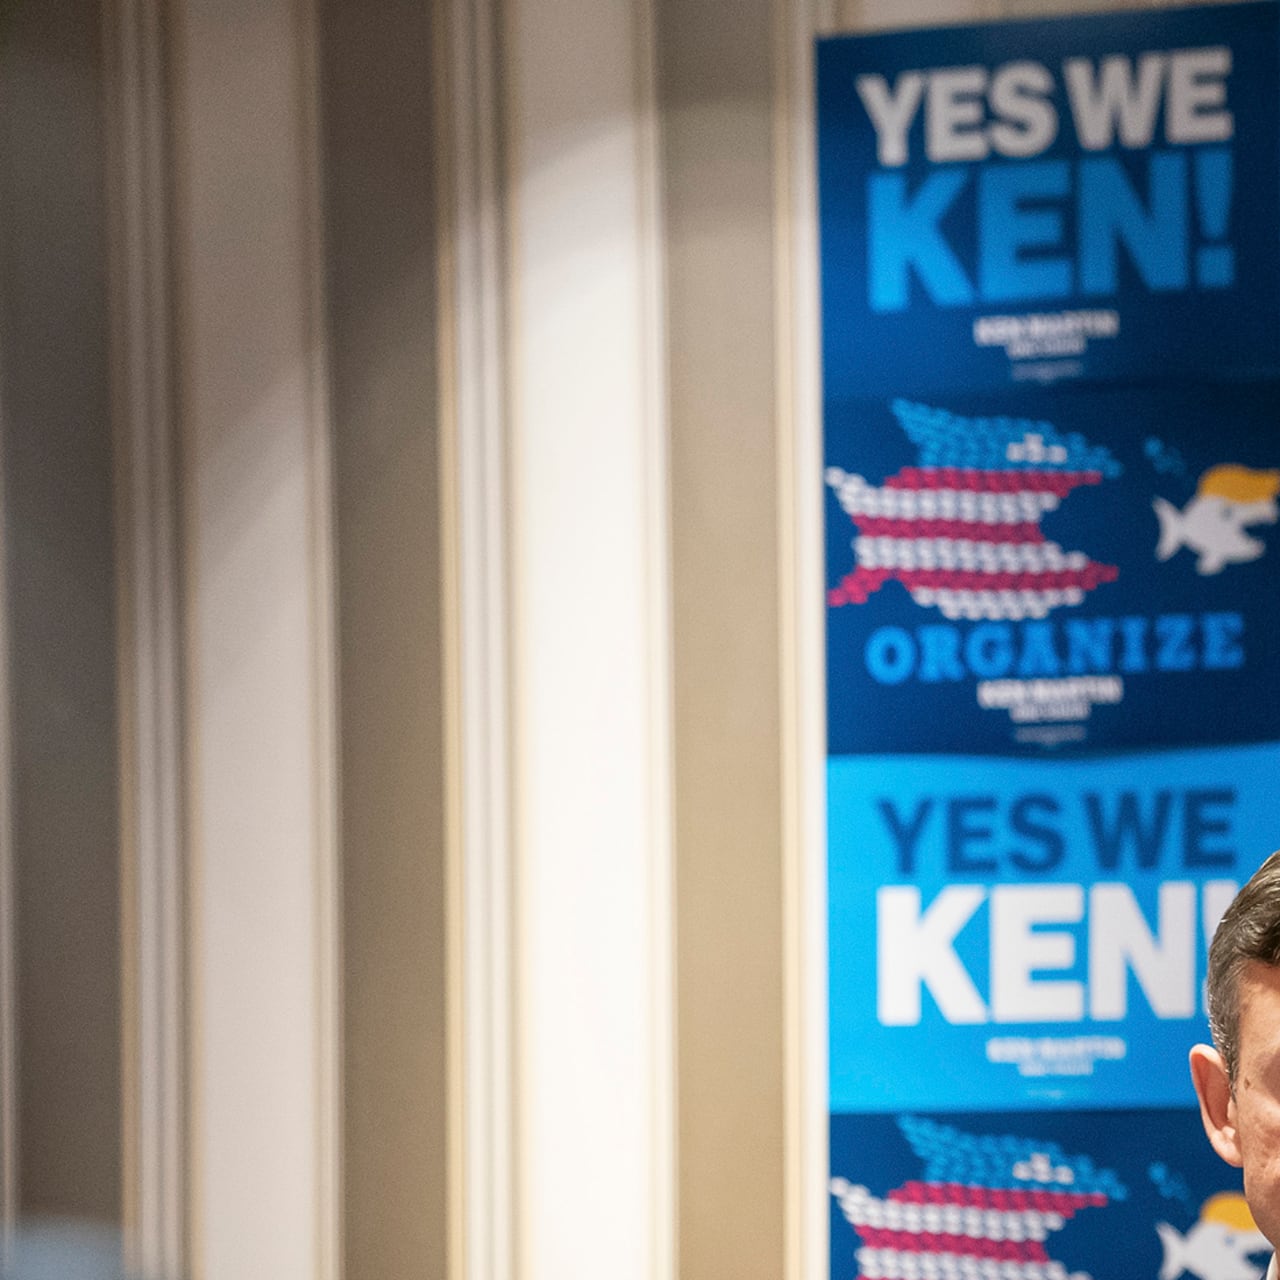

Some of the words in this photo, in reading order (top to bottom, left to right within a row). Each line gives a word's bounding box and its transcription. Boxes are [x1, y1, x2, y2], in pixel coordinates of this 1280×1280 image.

[856, 60, 1058, 167] YES
[1064, 46, 1234, 151] WE
[867, 148, 1234, 314] KEN!
[864, 612, 1245, 685] ORGANIZE
[877, 792, 1066, 875] YES
[1083, 788, 1237, 874] WE
